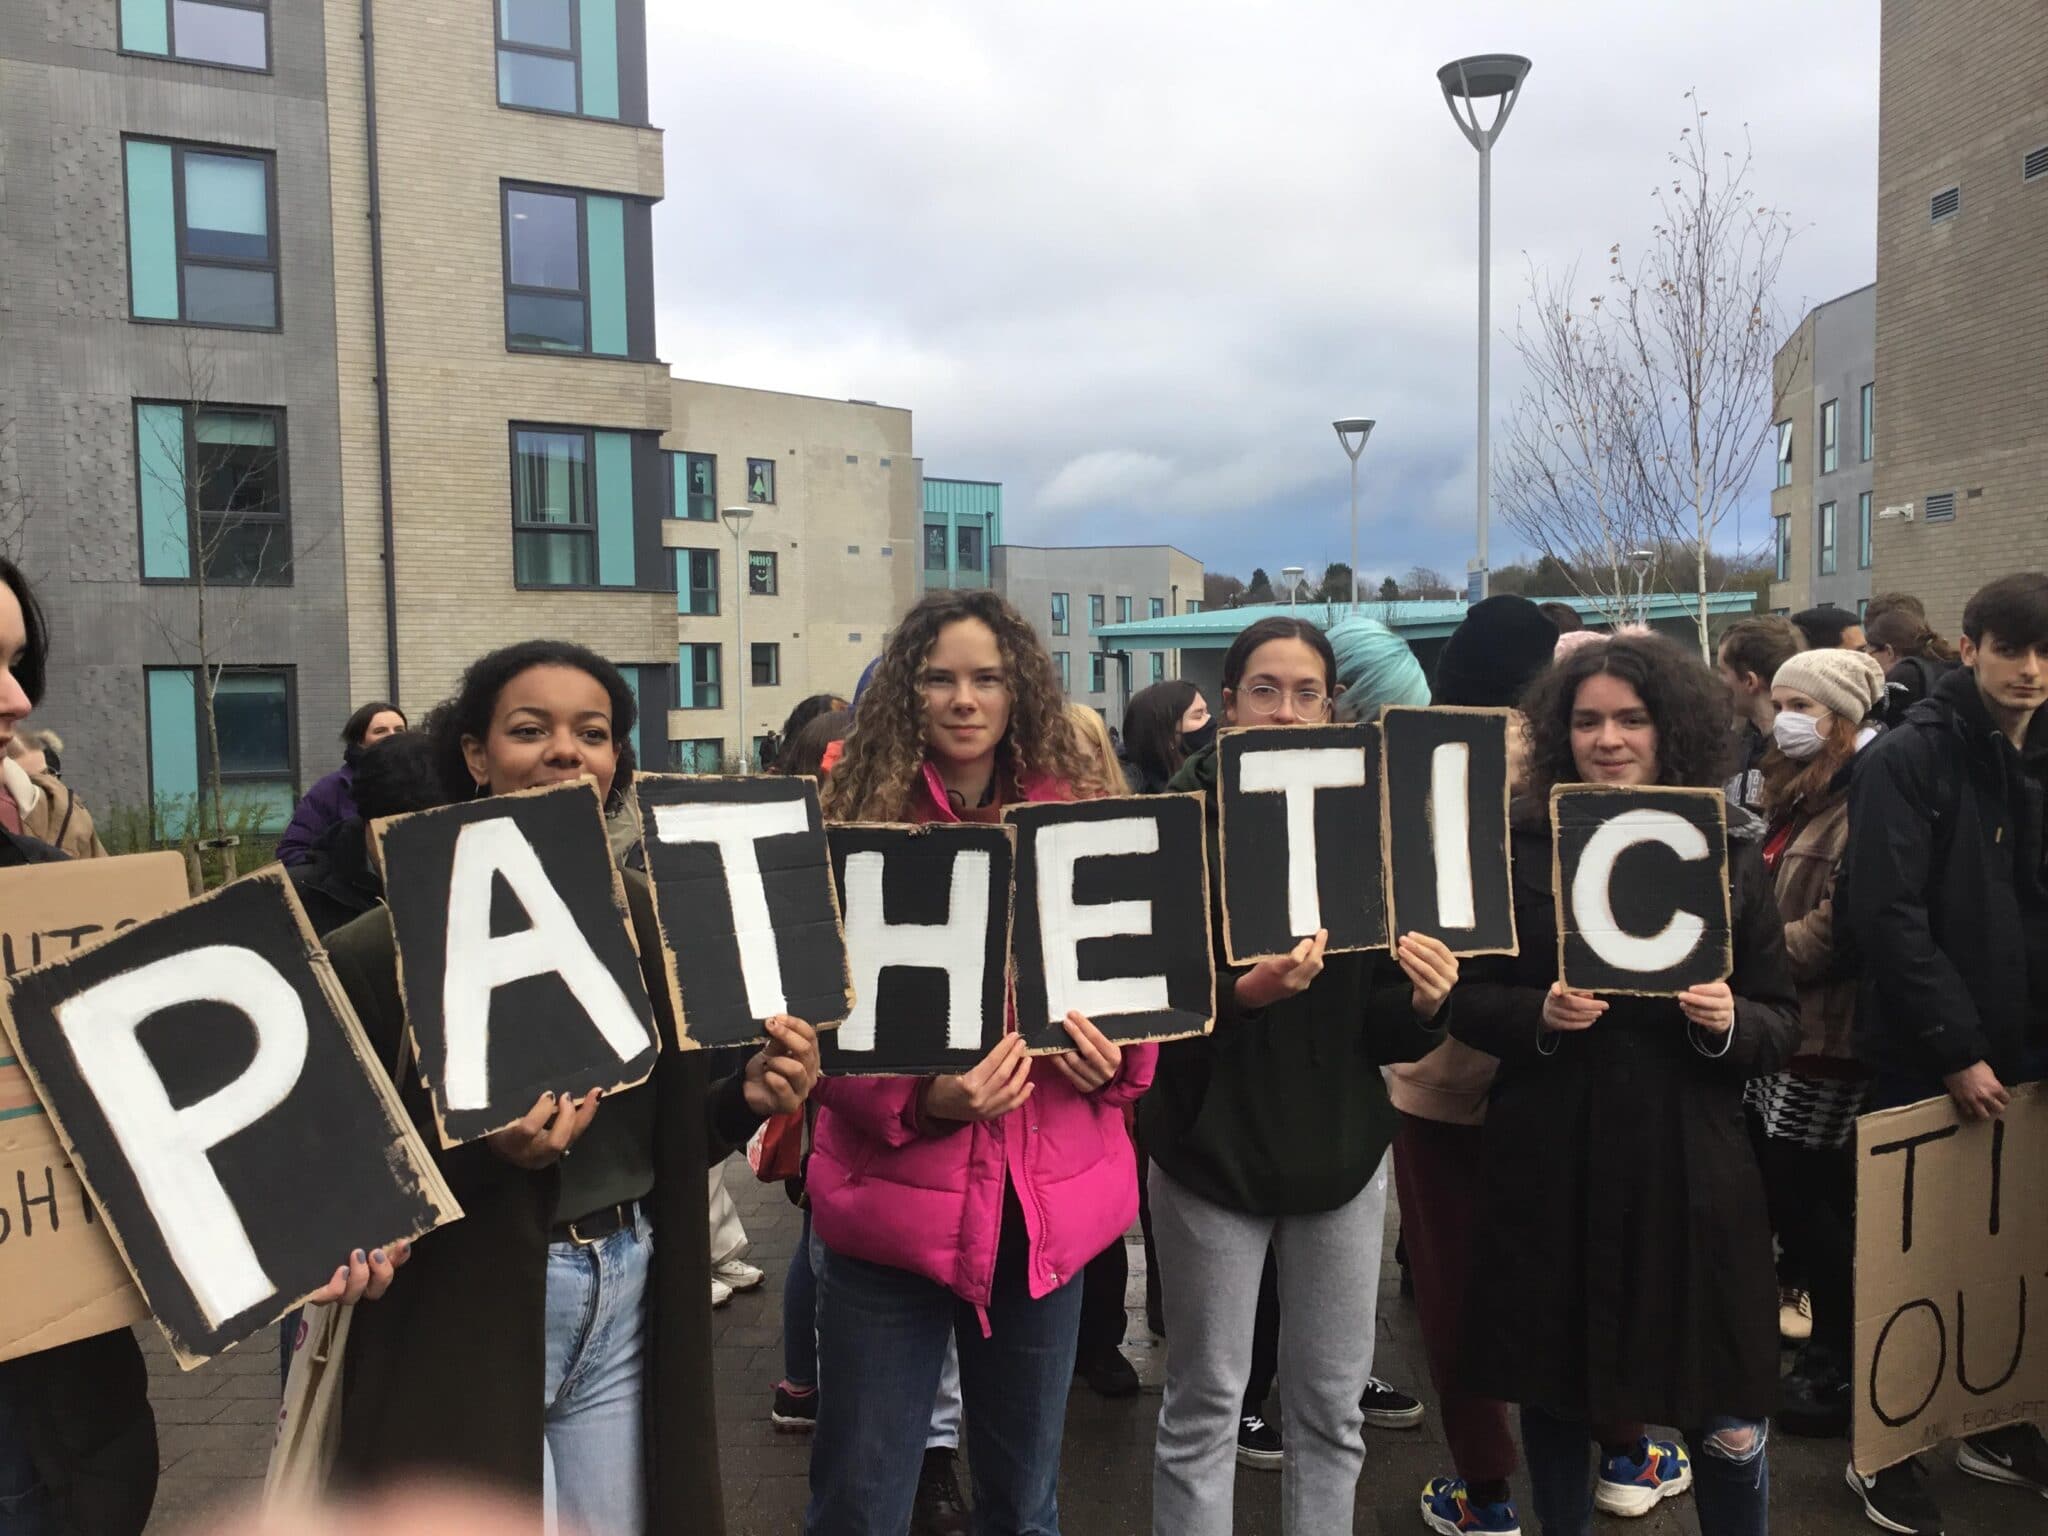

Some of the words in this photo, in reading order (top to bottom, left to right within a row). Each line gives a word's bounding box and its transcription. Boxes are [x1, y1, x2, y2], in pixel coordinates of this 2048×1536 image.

[57, 945, 308, 1331] P
[442, 816, 652, 1111] A
[653, 797, 810, 1022] T
[837, 851, 990, 1051] H
[1035, 817, 1171, 1023] E
[1239, 748, 1365, 939] T
[1430, 743, 1476, 928] I
[1572, 809, 1709, 972] C
[1869, 1271, 2048, 1427] OU
